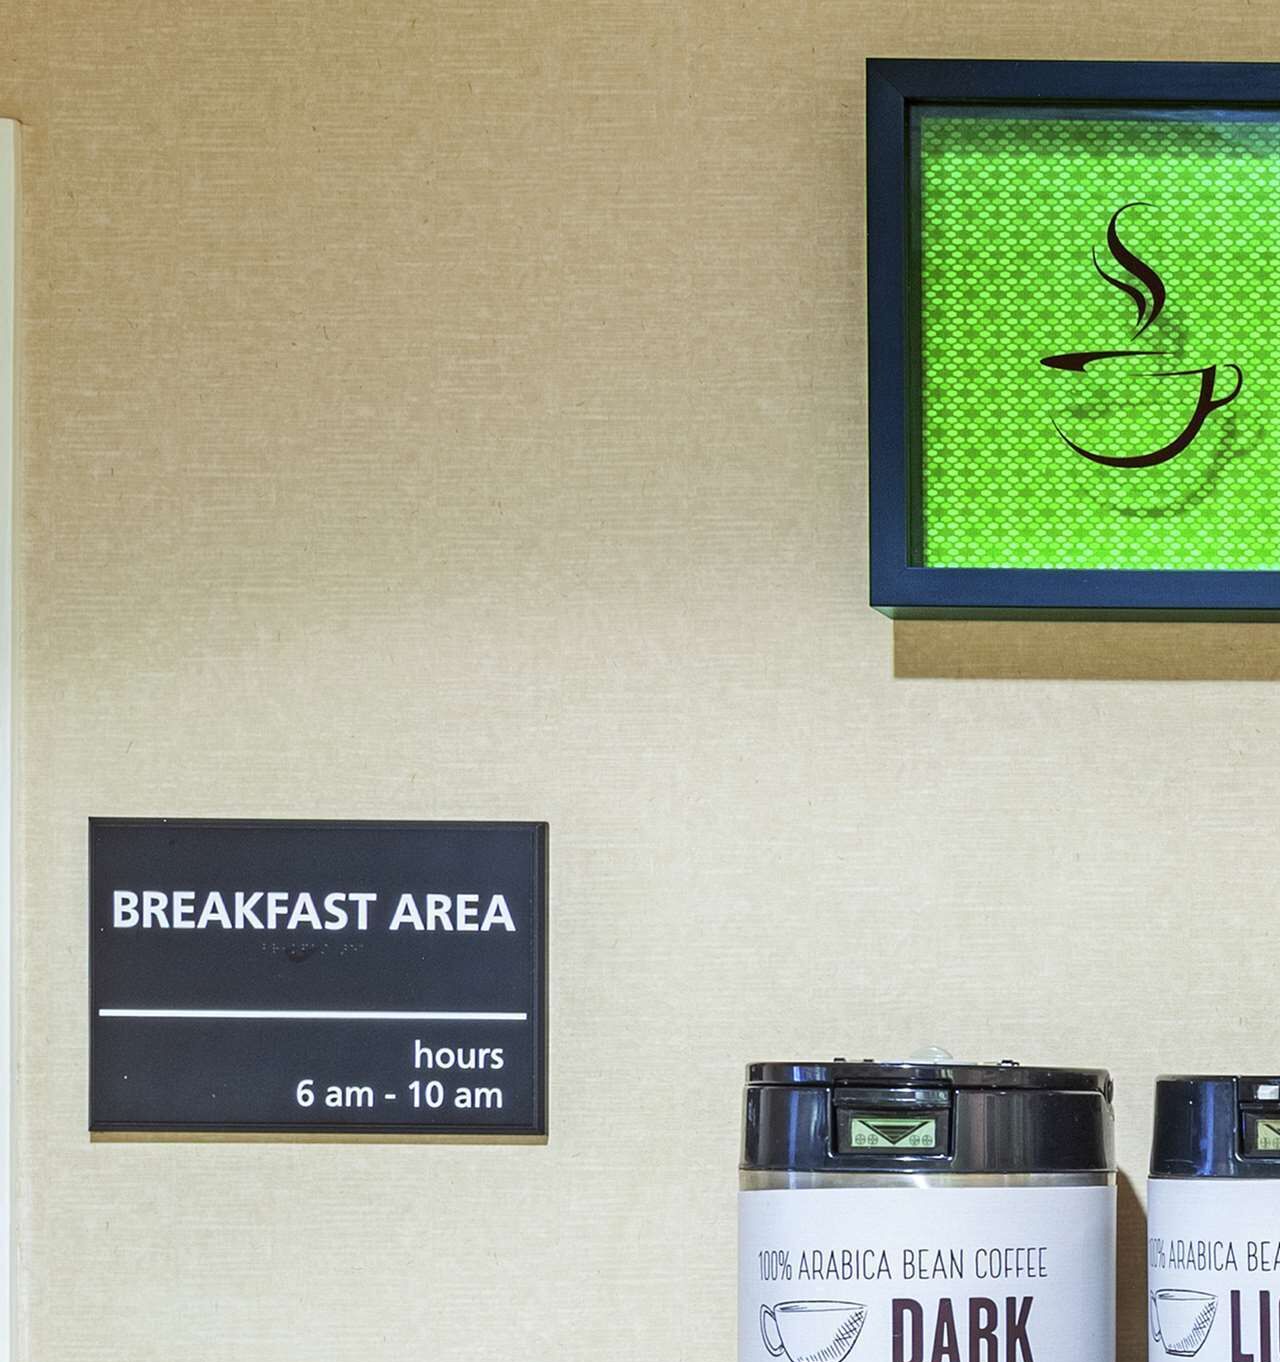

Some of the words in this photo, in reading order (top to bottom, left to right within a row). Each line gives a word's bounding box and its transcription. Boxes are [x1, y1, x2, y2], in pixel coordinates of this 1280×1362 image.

[113, 890, 377, 931] BREAKFAST
[388, 893, 516, 932] AREA
[414, 1039, 504, 1070] hours
[296, 1080, 314, 1108] 6
[325, 1086, 374, 1107] am
[408, 1081, 444, 1108] 10
[454, 1087, 503, 1108] am
[759, 1250, 792, 1281] 100%
[798, 1249, 892, 1280] ARABICA
[903, 1249, 963, 1279] BEAN
[975, 1247, 1048, 1279] COFFEE
[1169, 1239, 1237, 1271] ARABICA
